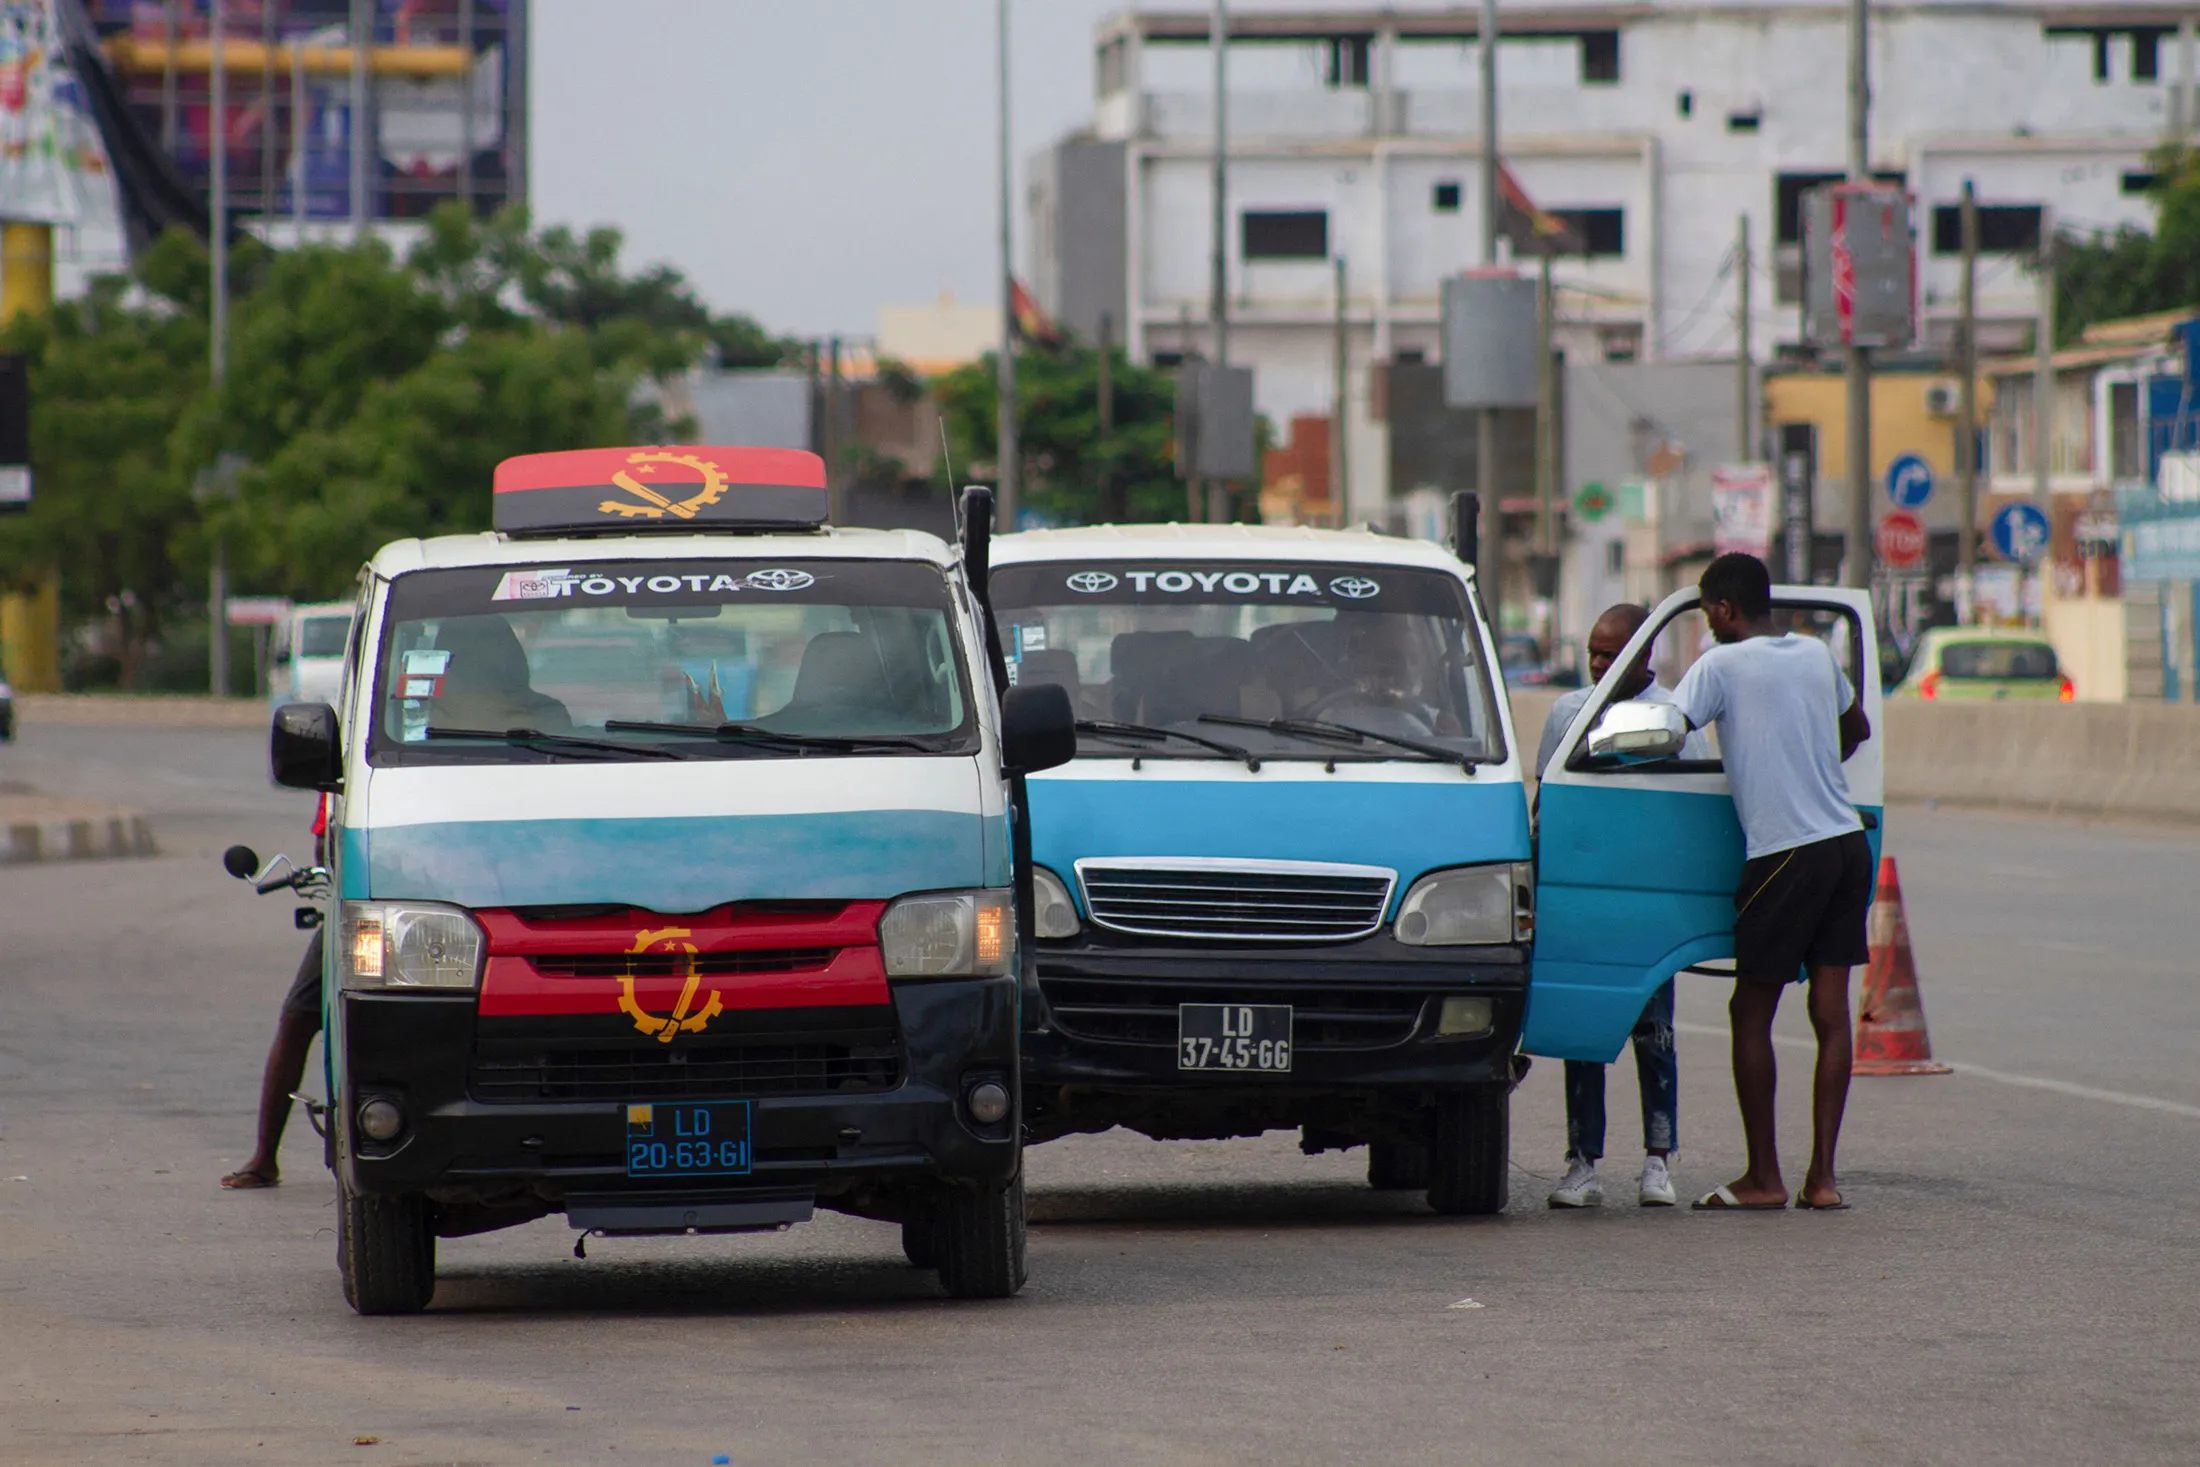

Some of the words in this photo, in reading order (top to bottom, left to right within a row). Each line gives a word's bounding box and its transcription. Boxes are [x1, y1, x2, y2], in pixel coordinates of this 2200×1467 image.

[1877, 529, 1922, 551] STOP
[552, 575, 739, 595] TOYOTA
[1125, 571, 1321, 595] TOYOTA
[1222, 1006, 1253, 1037] LD
[1182, 1037, 1288, 1070] 37-45-GG
[675, 1108, 710, 1136] LD
